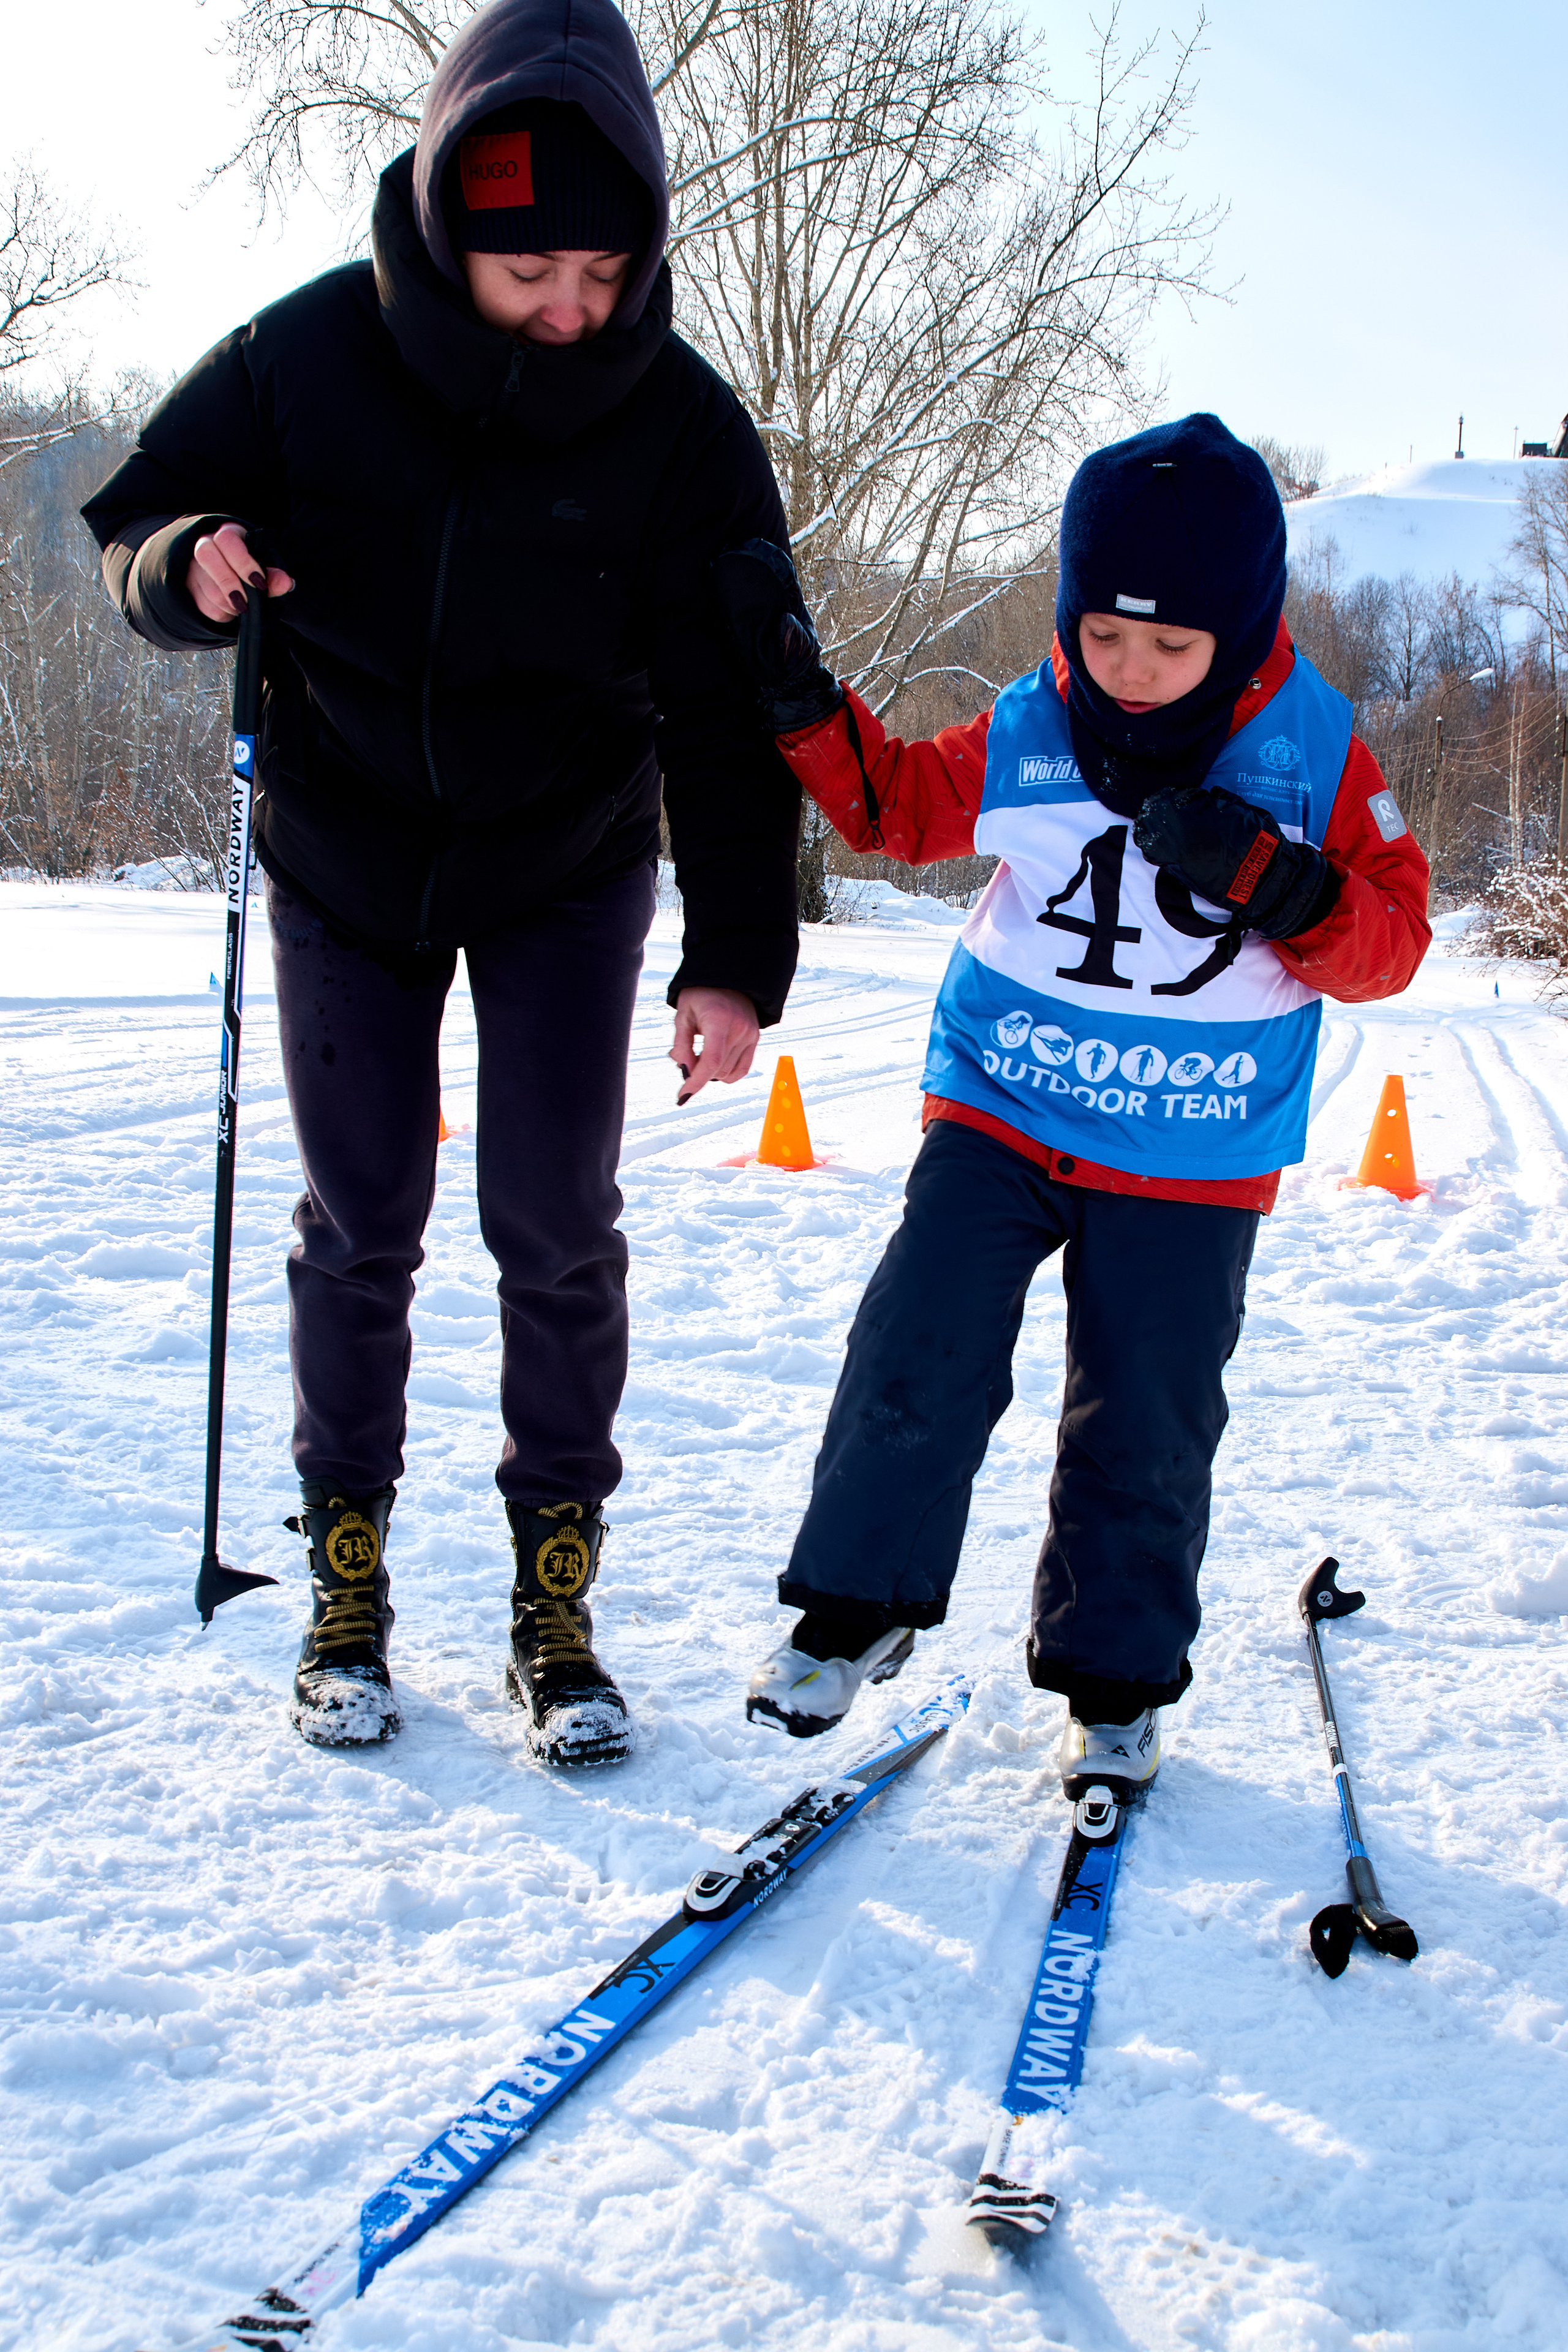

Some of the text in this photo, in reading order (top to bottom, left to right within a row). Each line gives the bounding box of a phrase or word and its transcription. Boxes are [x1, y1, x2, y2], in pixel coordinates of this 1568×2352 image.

[469, 160, 518, 180] HUGO
[1022, 759, 1073, 783] World
[1237, 772, 1312, 793] Пушкинский
[1386, 822, 1399, 833] TEC
[227, 785, 244, 904] NORDWAY
[1239, 869, 1258, 899] FOREST
[983, 1049, 1247, 1120] OUTDOOR TEAM
[218, 1115, 229, 1144] XC
[753, 1866, 788, 1909] NORDWAY
[1065, 1880, 1104, 1912] XC
[613, 1954, 677, 1994] XC
[1016, 1928, 1094, 2106] NORDWAY
[390, 2008, 616, 2215] NORDWAY
[1002, 2128, 1013, 2144] BASE
